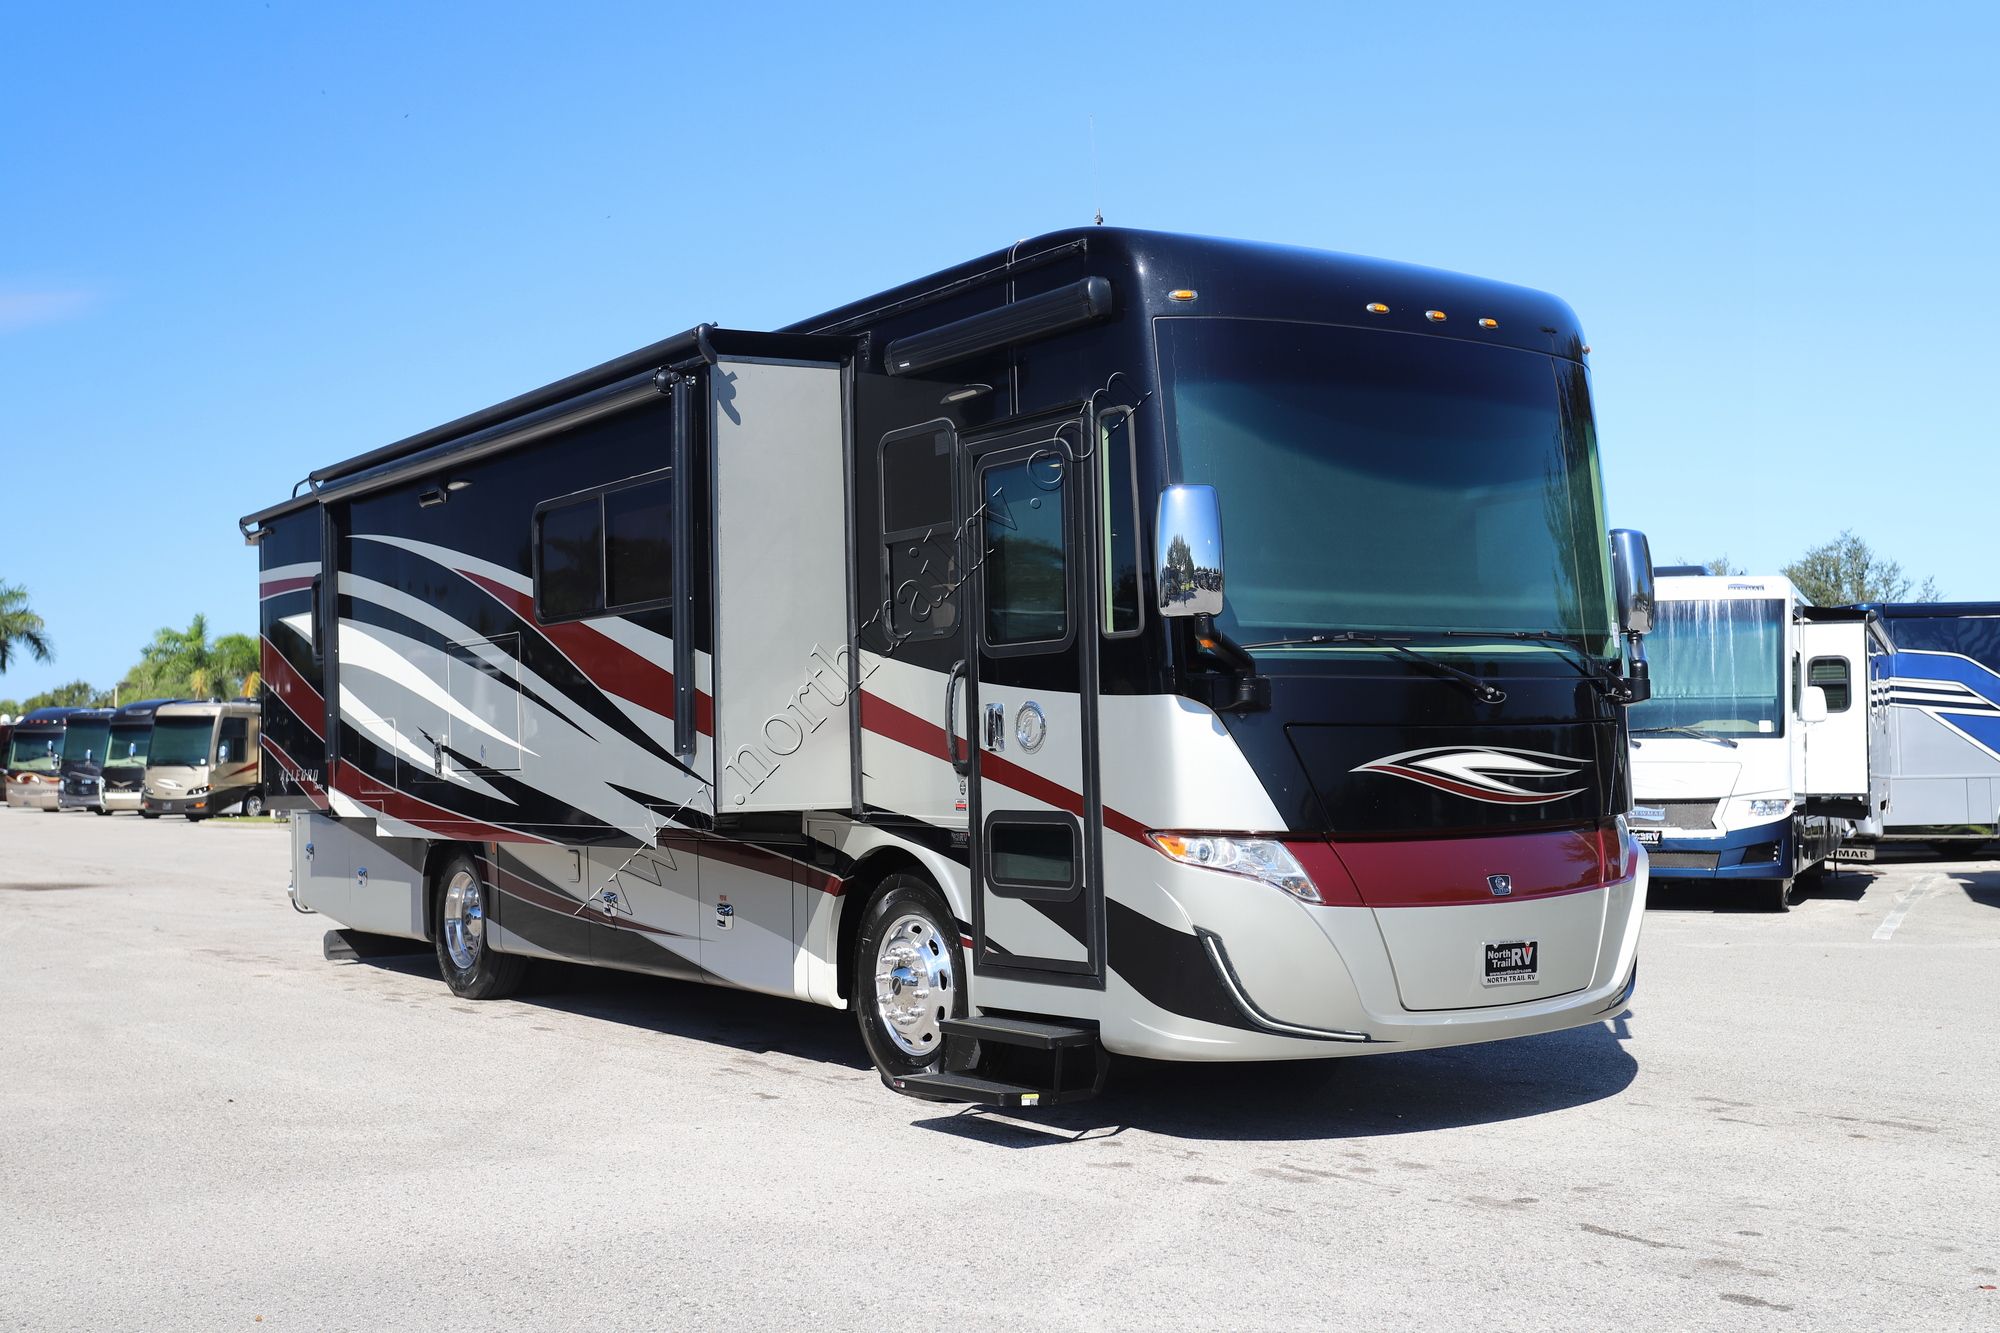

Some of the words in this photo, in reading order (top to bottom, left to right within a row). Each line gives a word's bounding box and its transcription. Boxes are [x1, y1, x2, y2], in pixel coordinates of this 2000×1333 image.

[280, 769, 318, 783] ALLEGRO
[1646, 832, 1660, 840] RV
[1829, 850, 1868, 858] MAR
[1488, 950, 1510, 959] North
[1512, 947, 1533, 966] RV
[1492, 959, 1510, 968] Trail
